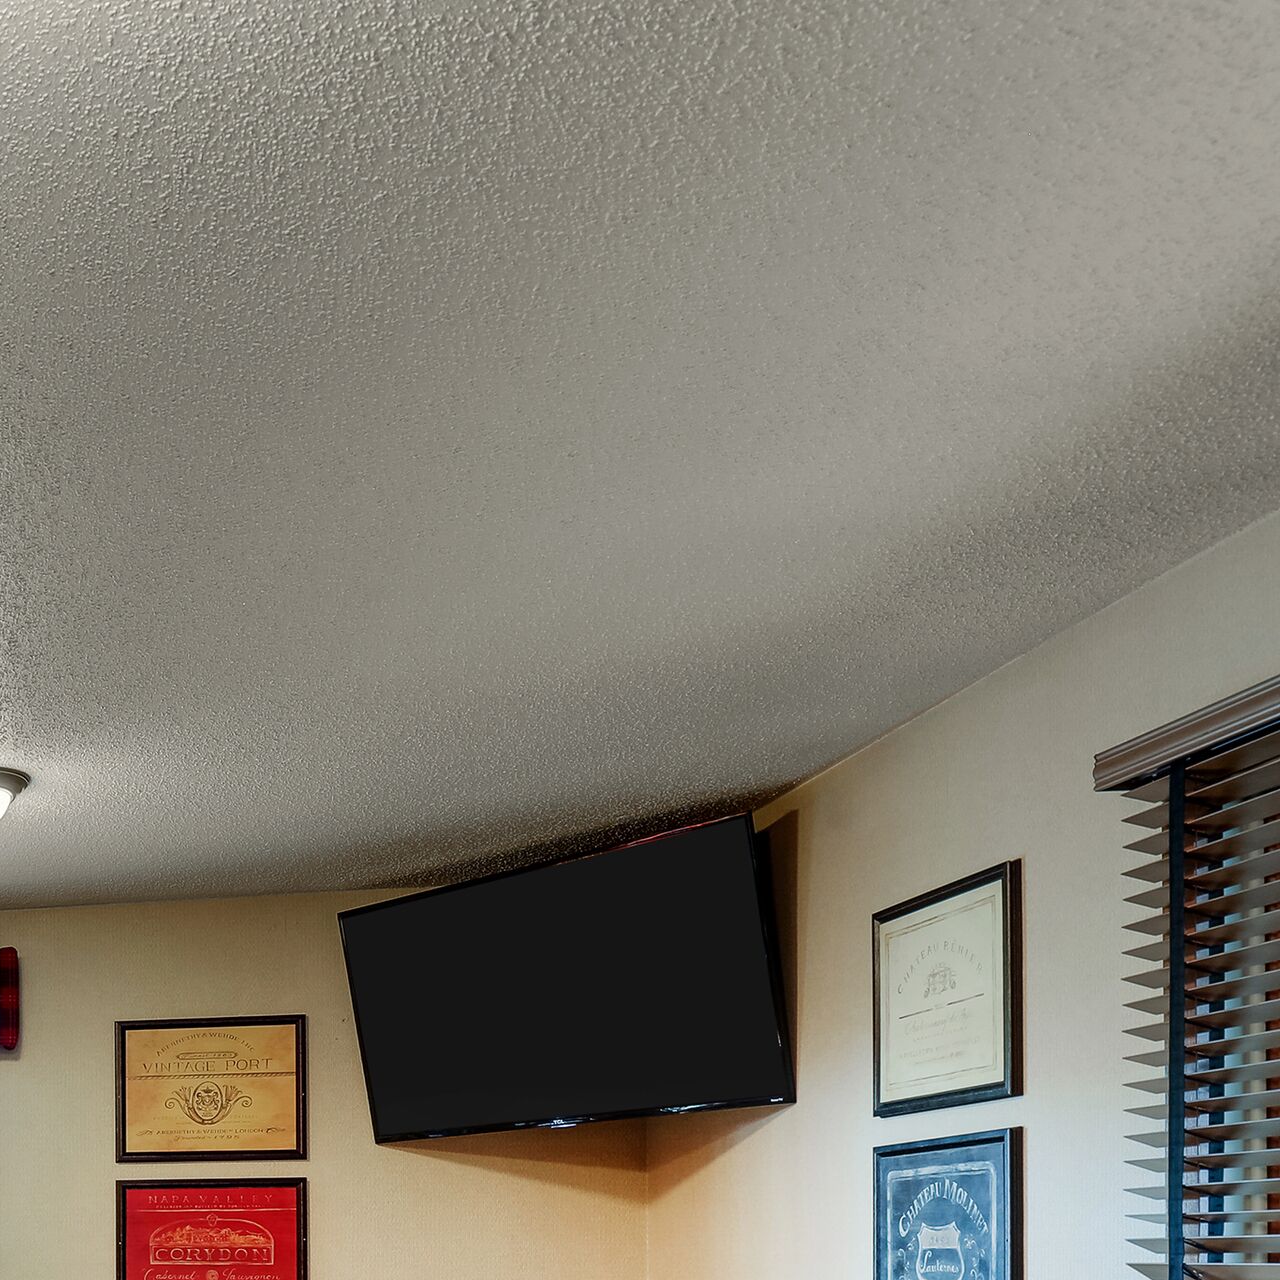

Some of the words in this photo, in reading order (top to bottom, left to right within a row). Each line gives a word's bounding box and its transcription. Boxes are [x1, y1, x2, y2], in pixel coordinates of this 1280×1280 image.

[142, 1060, 216, 1074] VINTAGE
[225, 1058, 273, 1071] PORT
[148, 1195, 190, 1204] NAPA
[199, 1195, 273, 1203] VALLEY
[899, 1182, 942, 1237] CHATEAU
[943, 1178, 989, 1235] MOLINET
[155, 1248, 269, 1261] CORYDON
